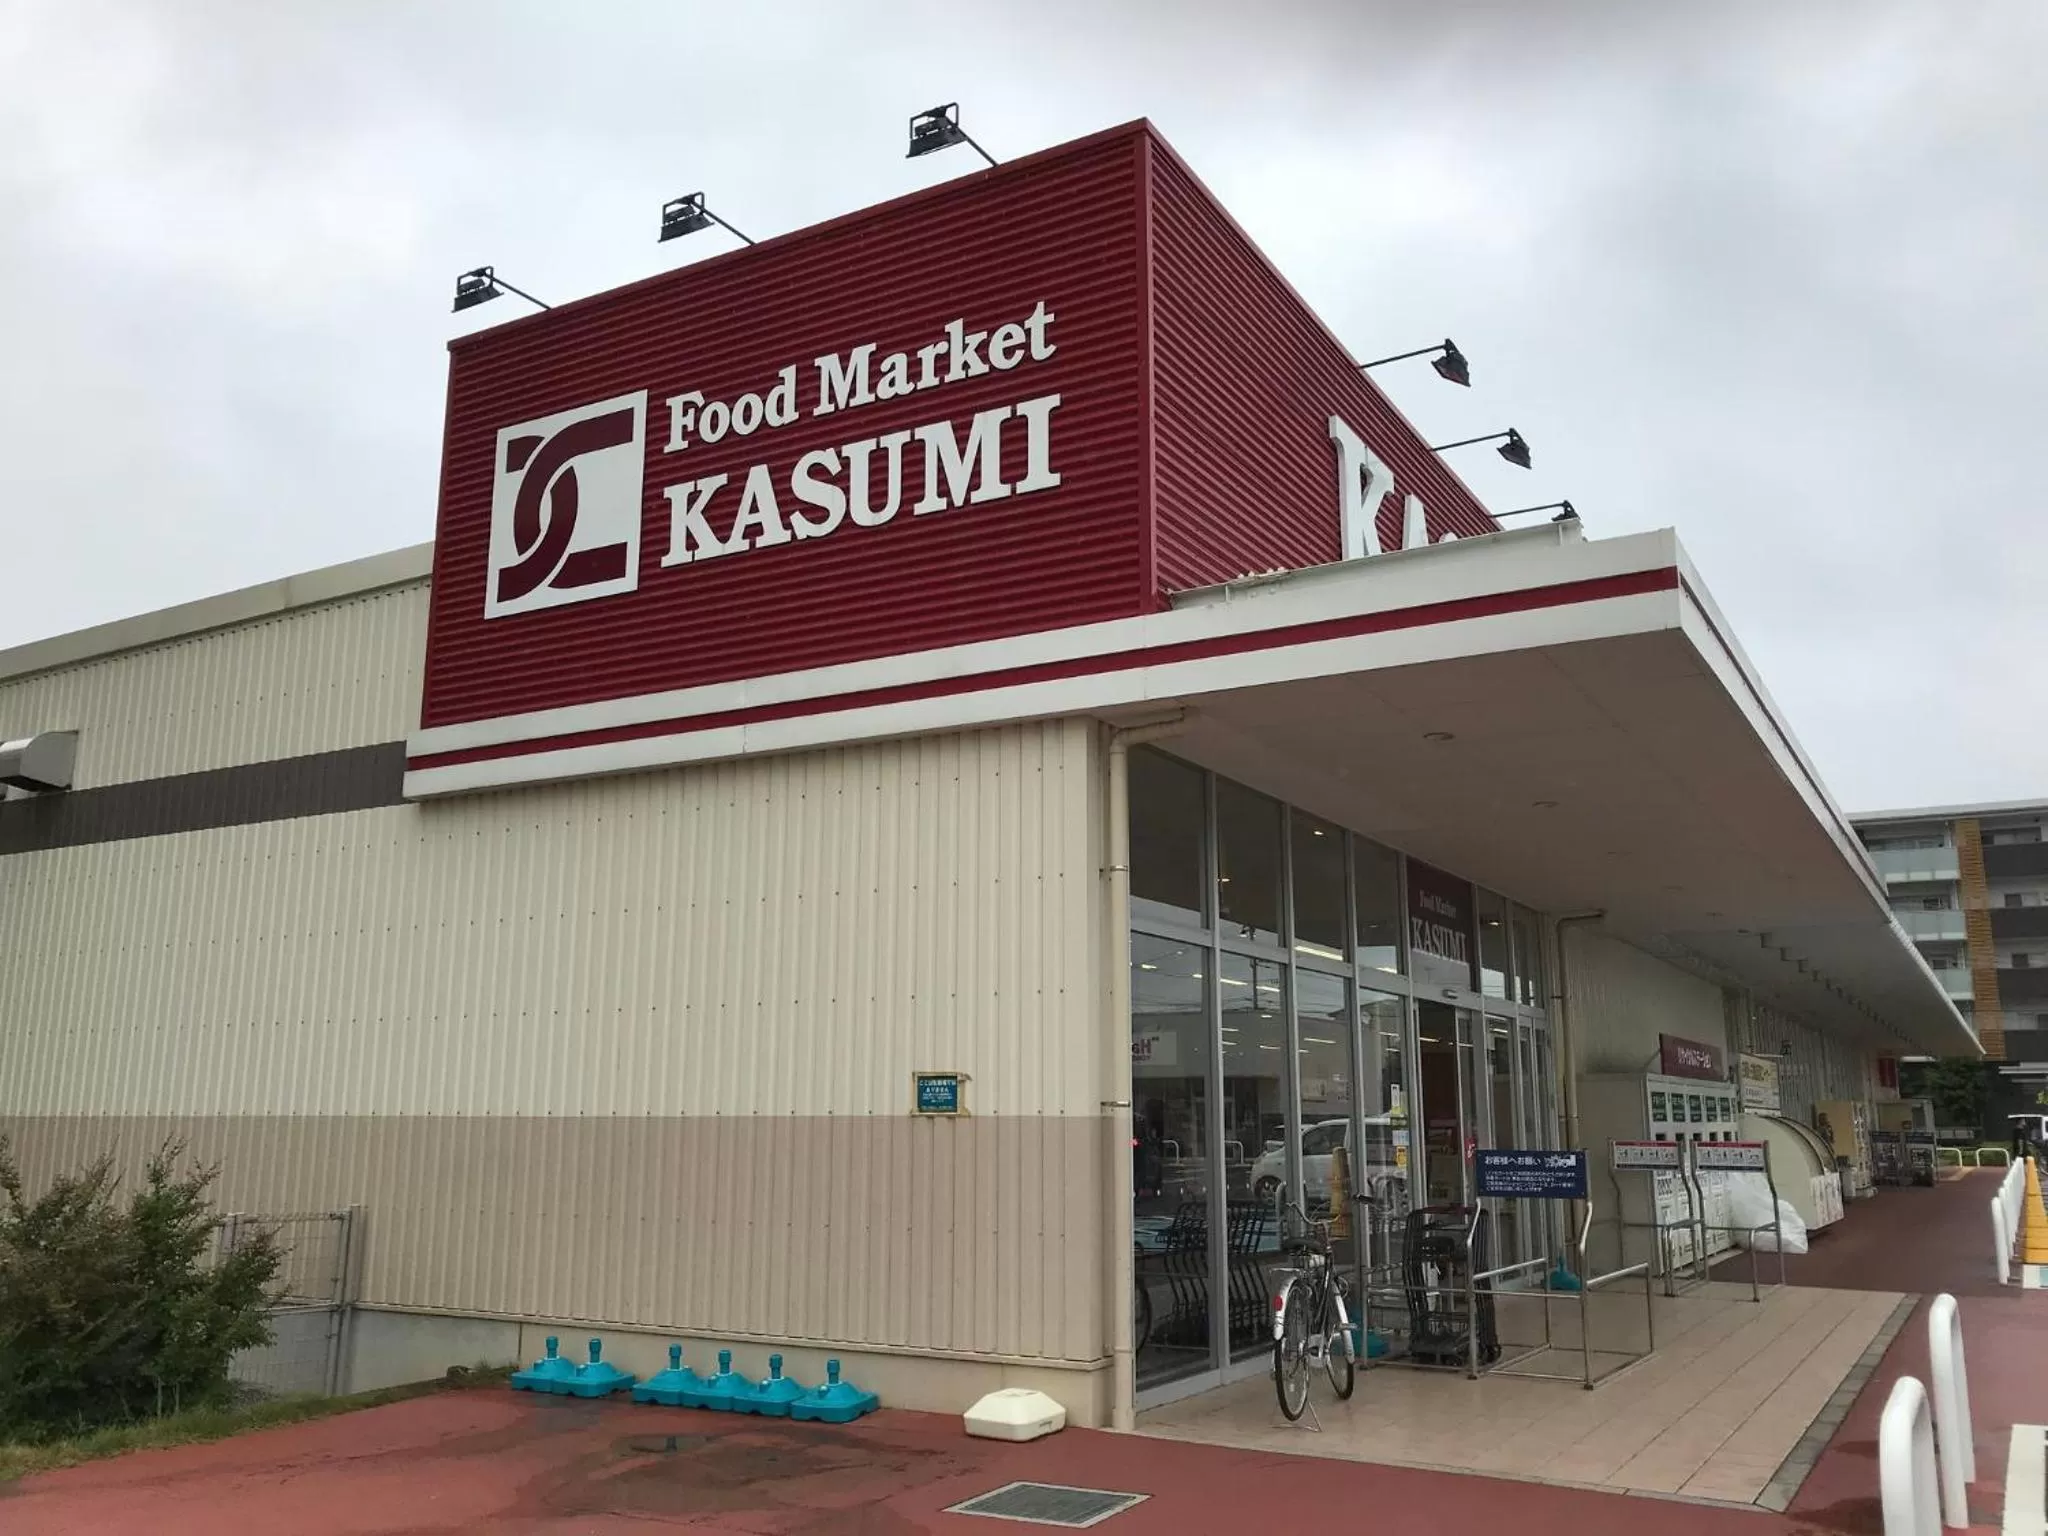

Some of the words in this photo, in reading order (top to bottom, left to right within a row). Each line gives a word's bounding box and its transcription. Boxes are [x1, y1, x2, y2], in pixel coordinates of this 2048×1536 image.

[663, 364, 799, 453] Food
[812, 301, 1057, 418] Market
[660, 393, 1062, 569] KASUMI
[1411, 915, 1467, 963] KASUMI
